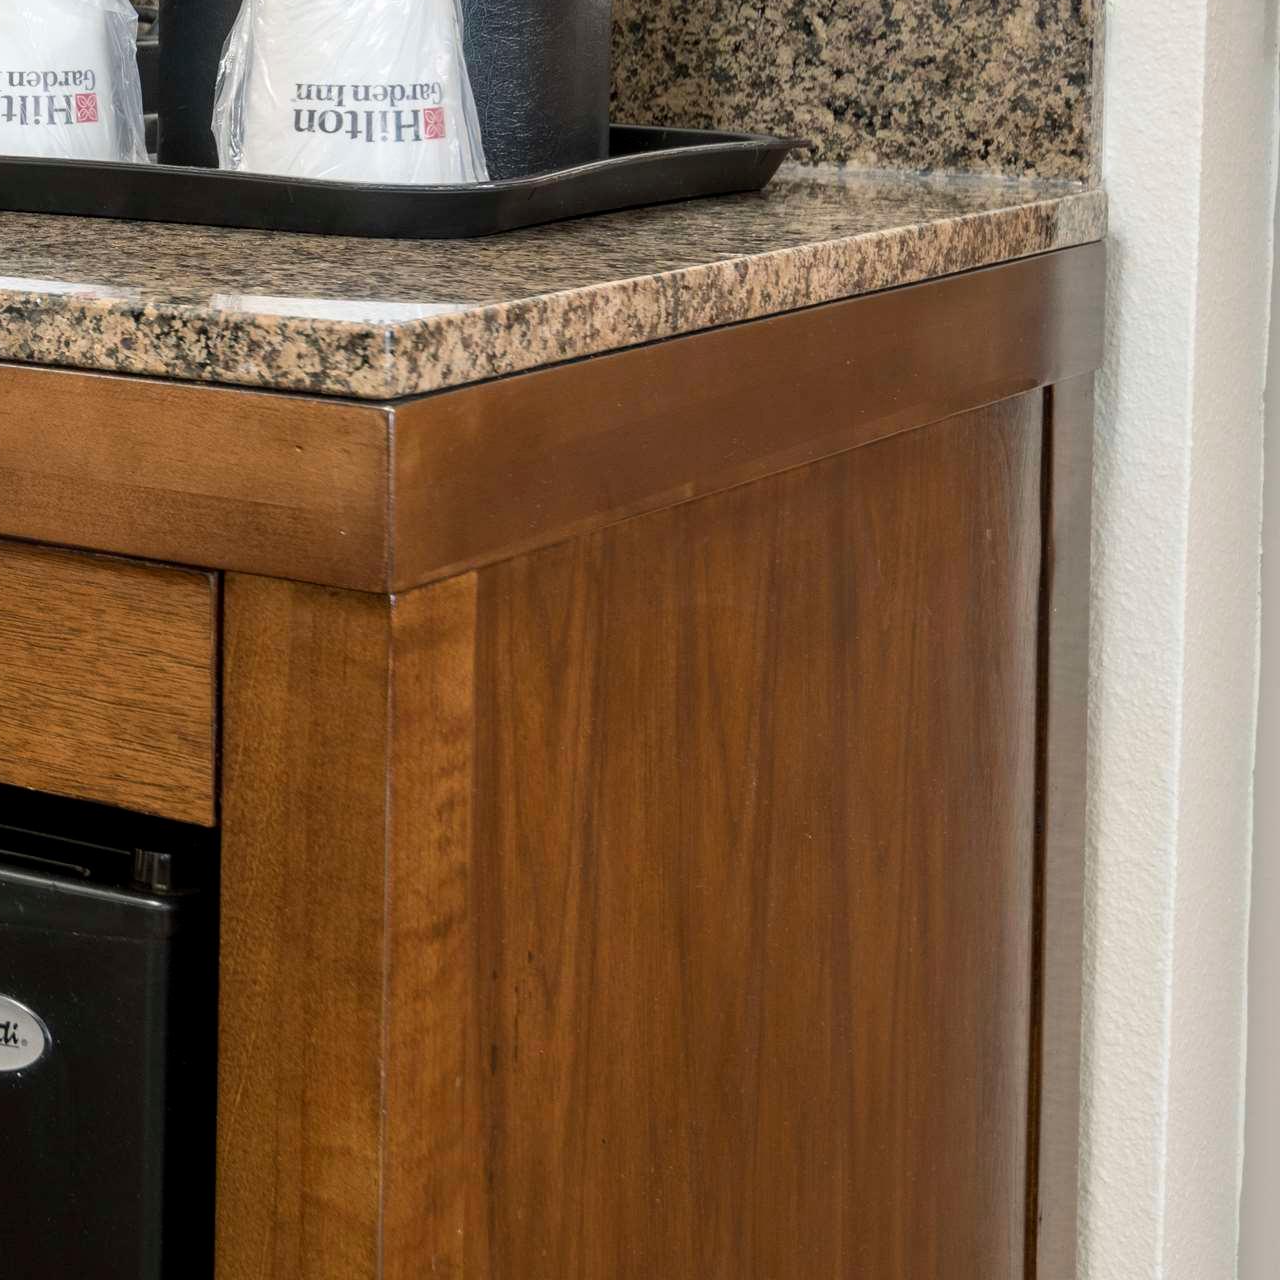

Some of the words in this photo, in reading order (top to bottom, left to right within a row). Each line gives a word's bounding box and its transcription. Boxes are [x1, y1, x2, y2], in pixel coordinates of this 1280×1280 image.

[8, 69, 96, 92] Garden
[295, 83, 347, 107] Inn
[351, 81, 443, 107] Garden
[293, 108, 423, 143] Hilton
